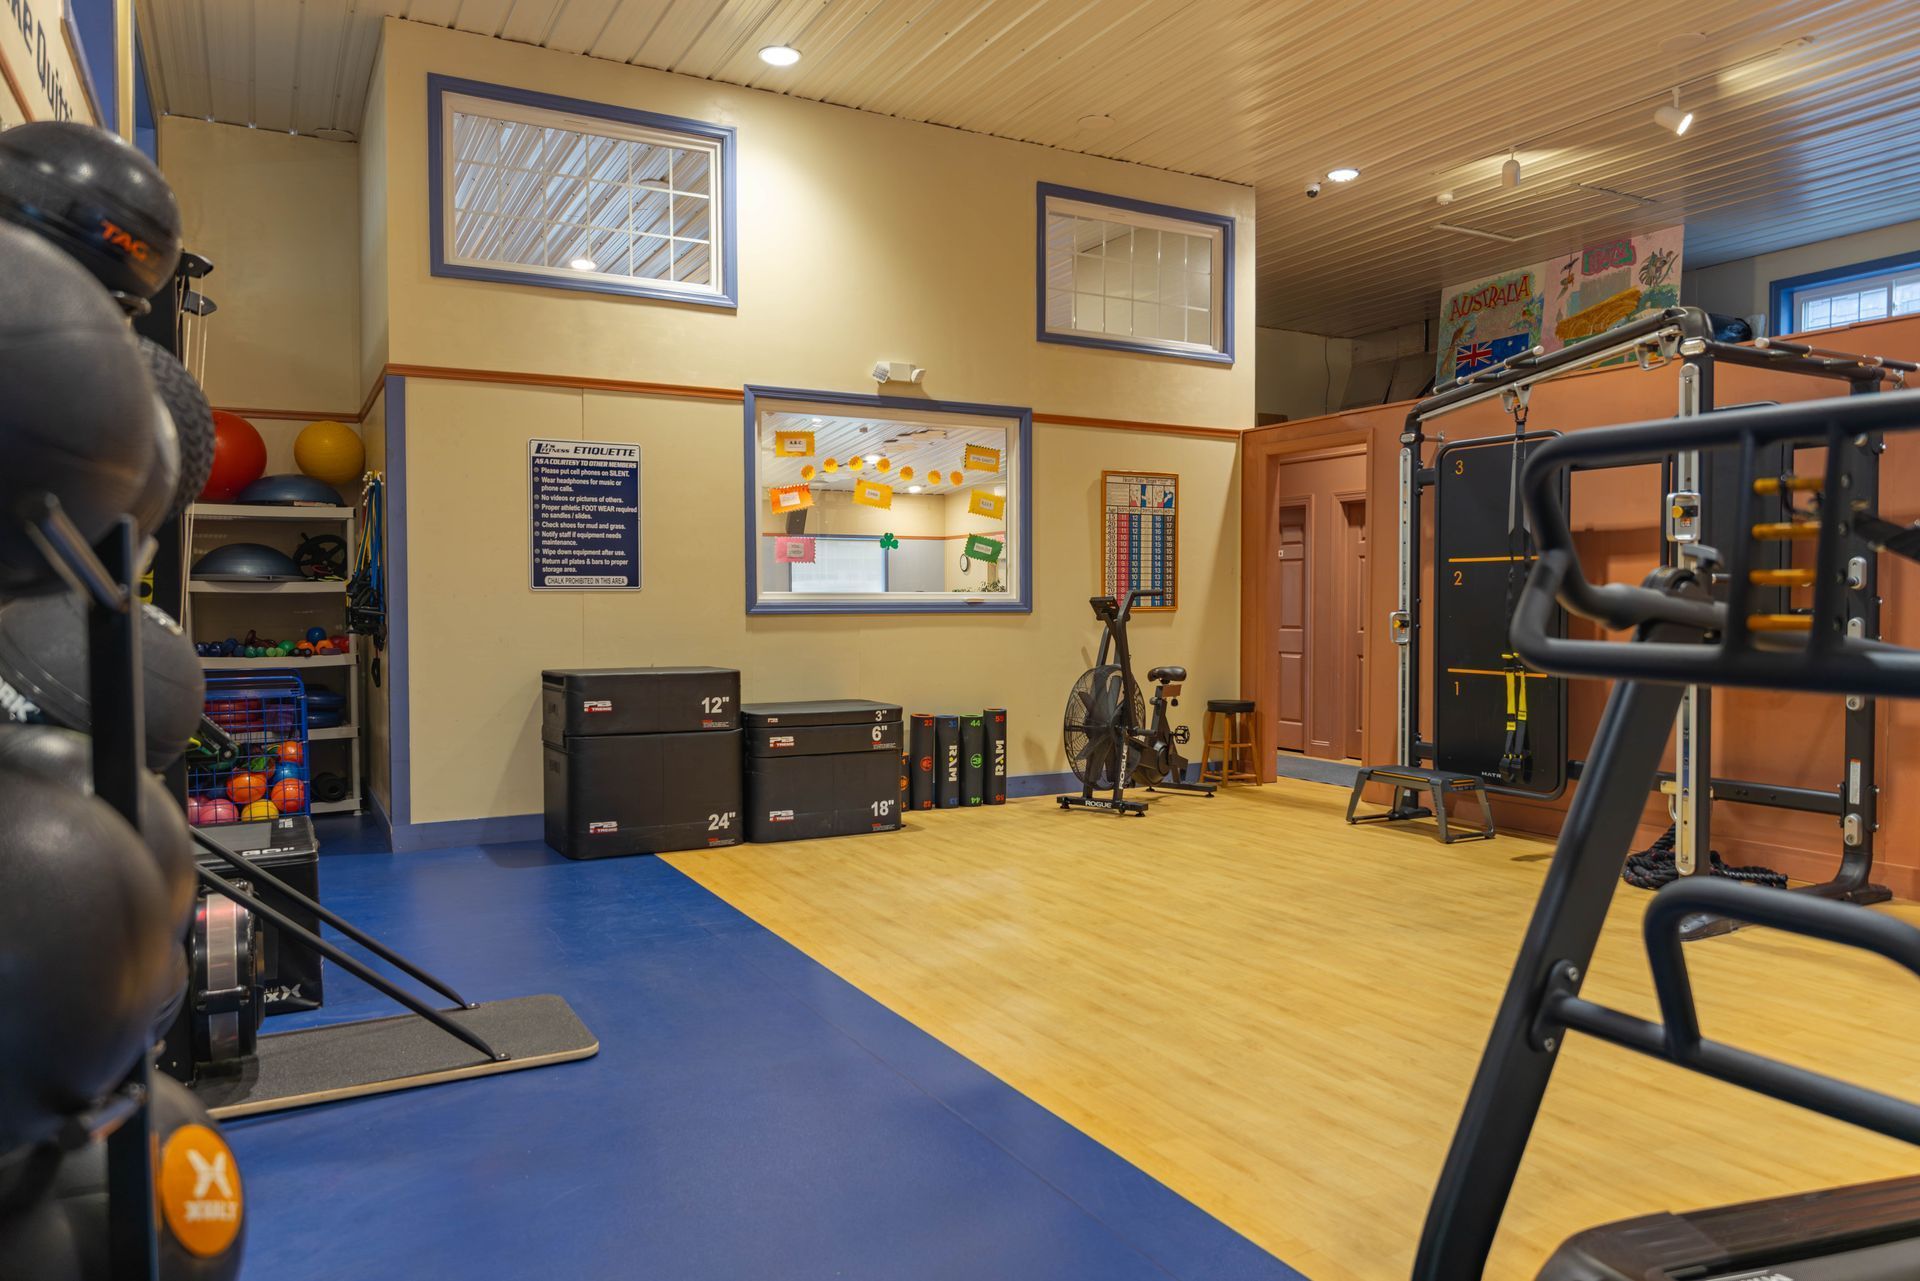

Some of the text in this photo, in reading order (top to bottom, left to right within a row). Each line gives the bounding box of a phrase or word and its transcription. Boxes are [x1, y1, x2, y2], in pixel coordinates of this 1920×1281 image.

[1449, 275, 1530, 321] AUSTRALIA
[574, 446, 636, 457] ETIQUETTE
[1455, 460, 1464, 475] 3
[1453, 571, 1463, 585] 2
[1454, 681, 1459, 696] 1
[701, 696, 729, 714] 12"
[875, 710, 887, 722] 3"
[871, 725, 888, 742] 6"
[1118, 742, 1129, 789] ROGUE
[871, 800, 895, 816] 18"
[1085, 800, 1112, 808] ROGUE
[708, 812, 736, 831] 24"
